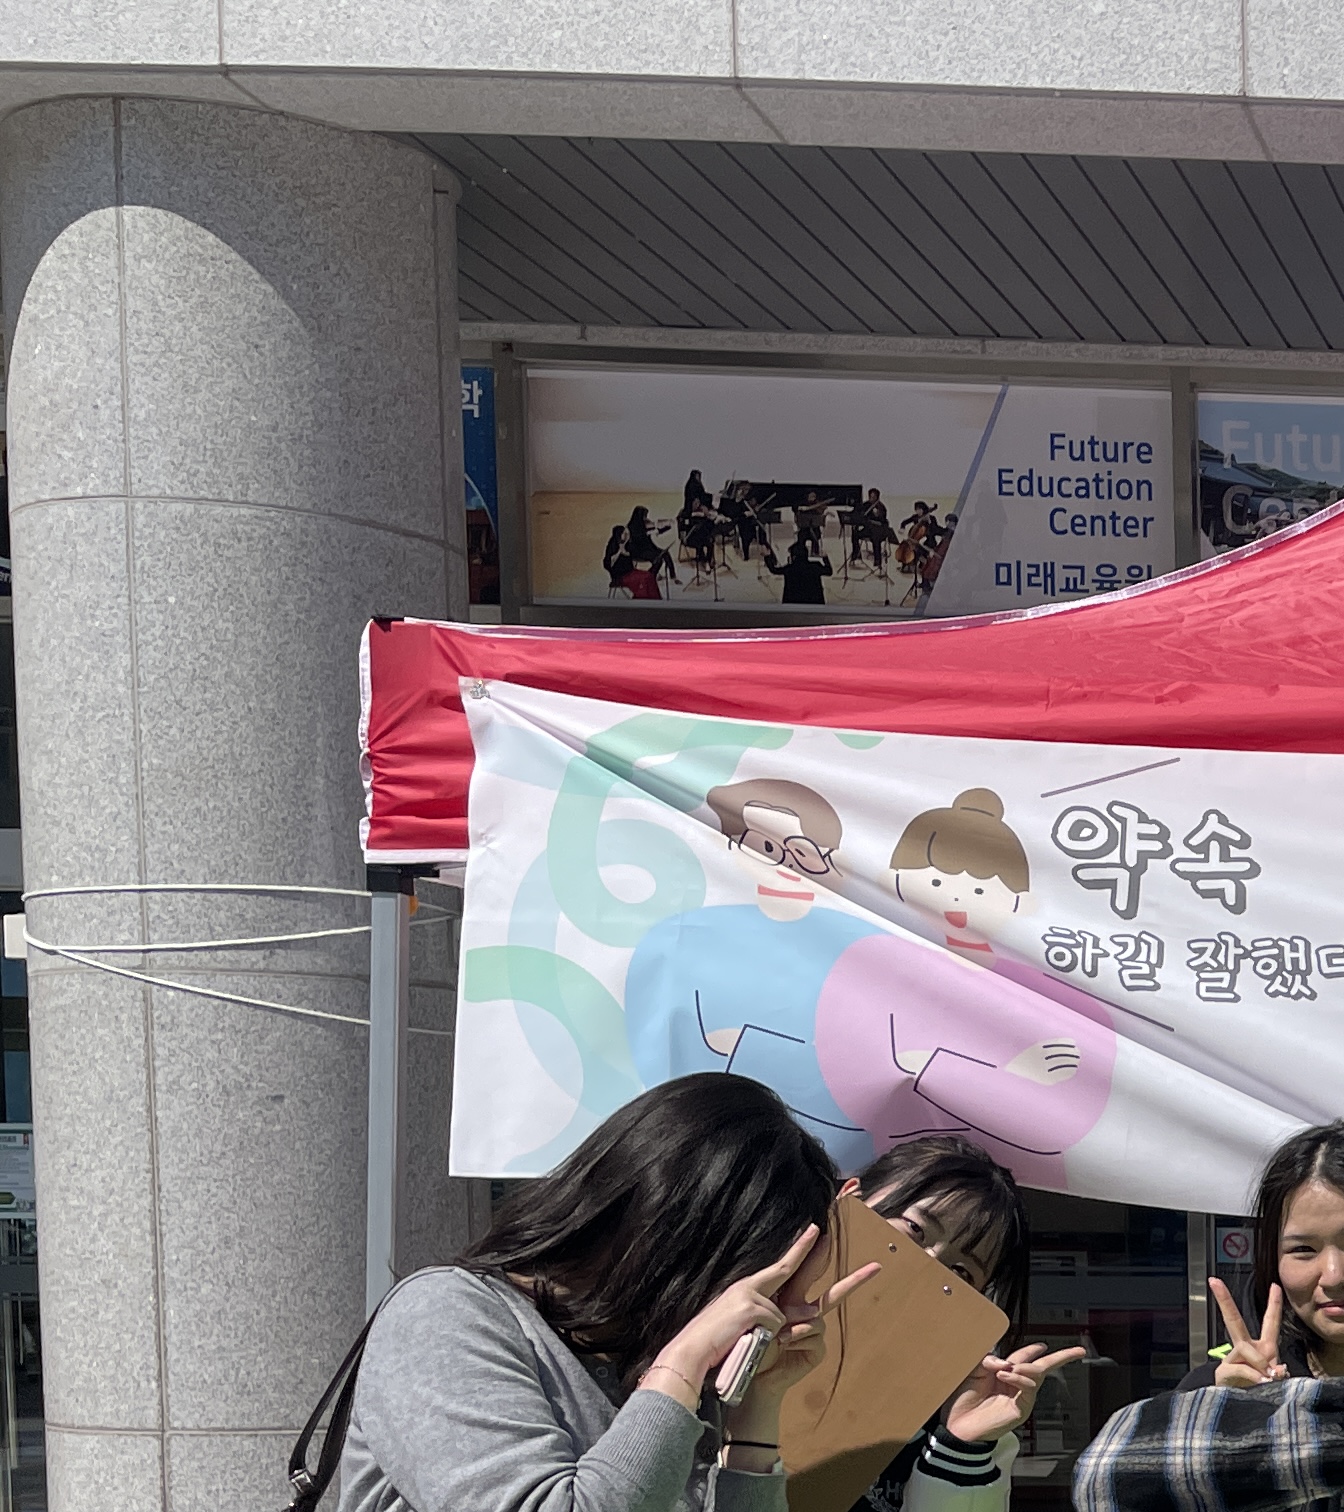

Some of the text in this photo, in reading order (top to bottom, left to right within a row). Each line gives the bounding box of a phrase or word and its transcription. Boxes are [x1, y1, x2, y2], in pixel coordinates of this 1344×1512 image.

[1049, 432, 1153, 465] Future
[997, 467, 1153, 502] Education
[1049, 507, 1155, 538] Center
[1051, 800, 1262, 920] 약속
[1041, 926, 1165, 992] 하길
